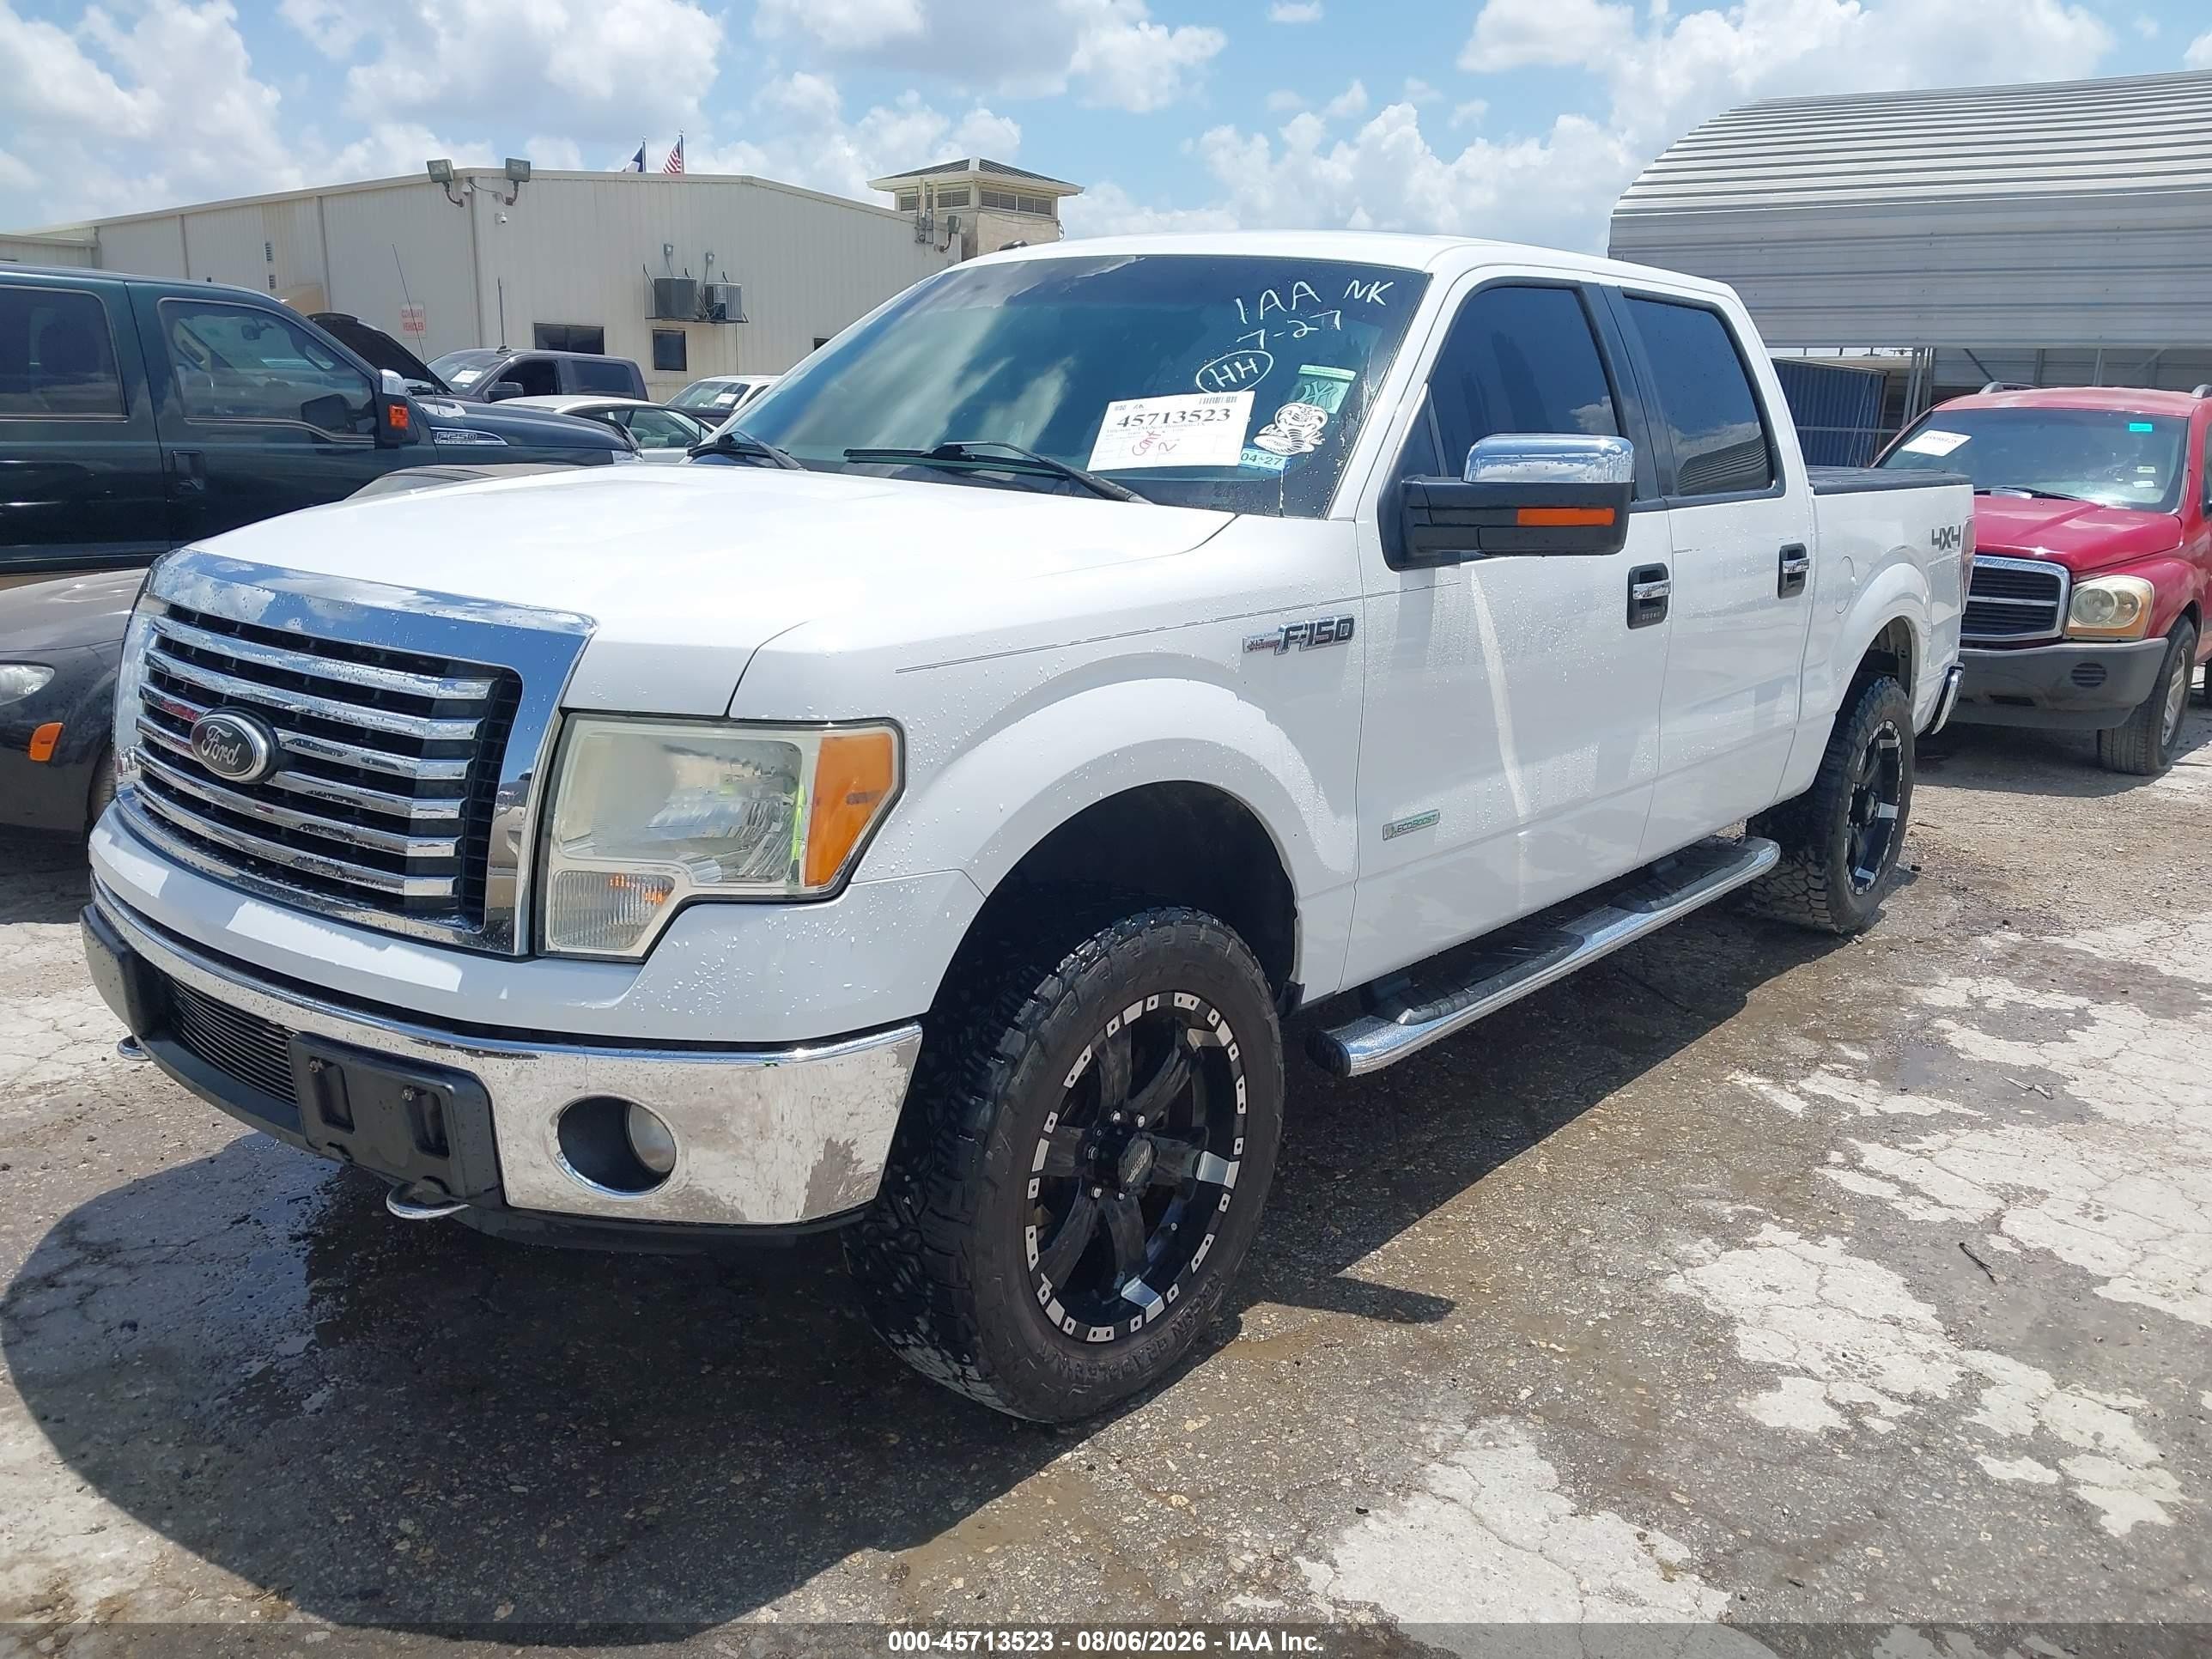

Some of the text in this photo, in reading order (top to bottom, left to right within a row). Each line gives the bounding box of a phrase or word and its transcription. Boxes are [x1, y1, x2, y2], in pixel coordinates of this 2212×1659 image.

[1236, 280, 1394, 324] IAA NK
[1236, 310, 1341, 349] 7-27
[1209, 358, 1259, 387] HH
[1117, 408, 1231, 428] 45713523
[201, 725, 241, 766] Ford
